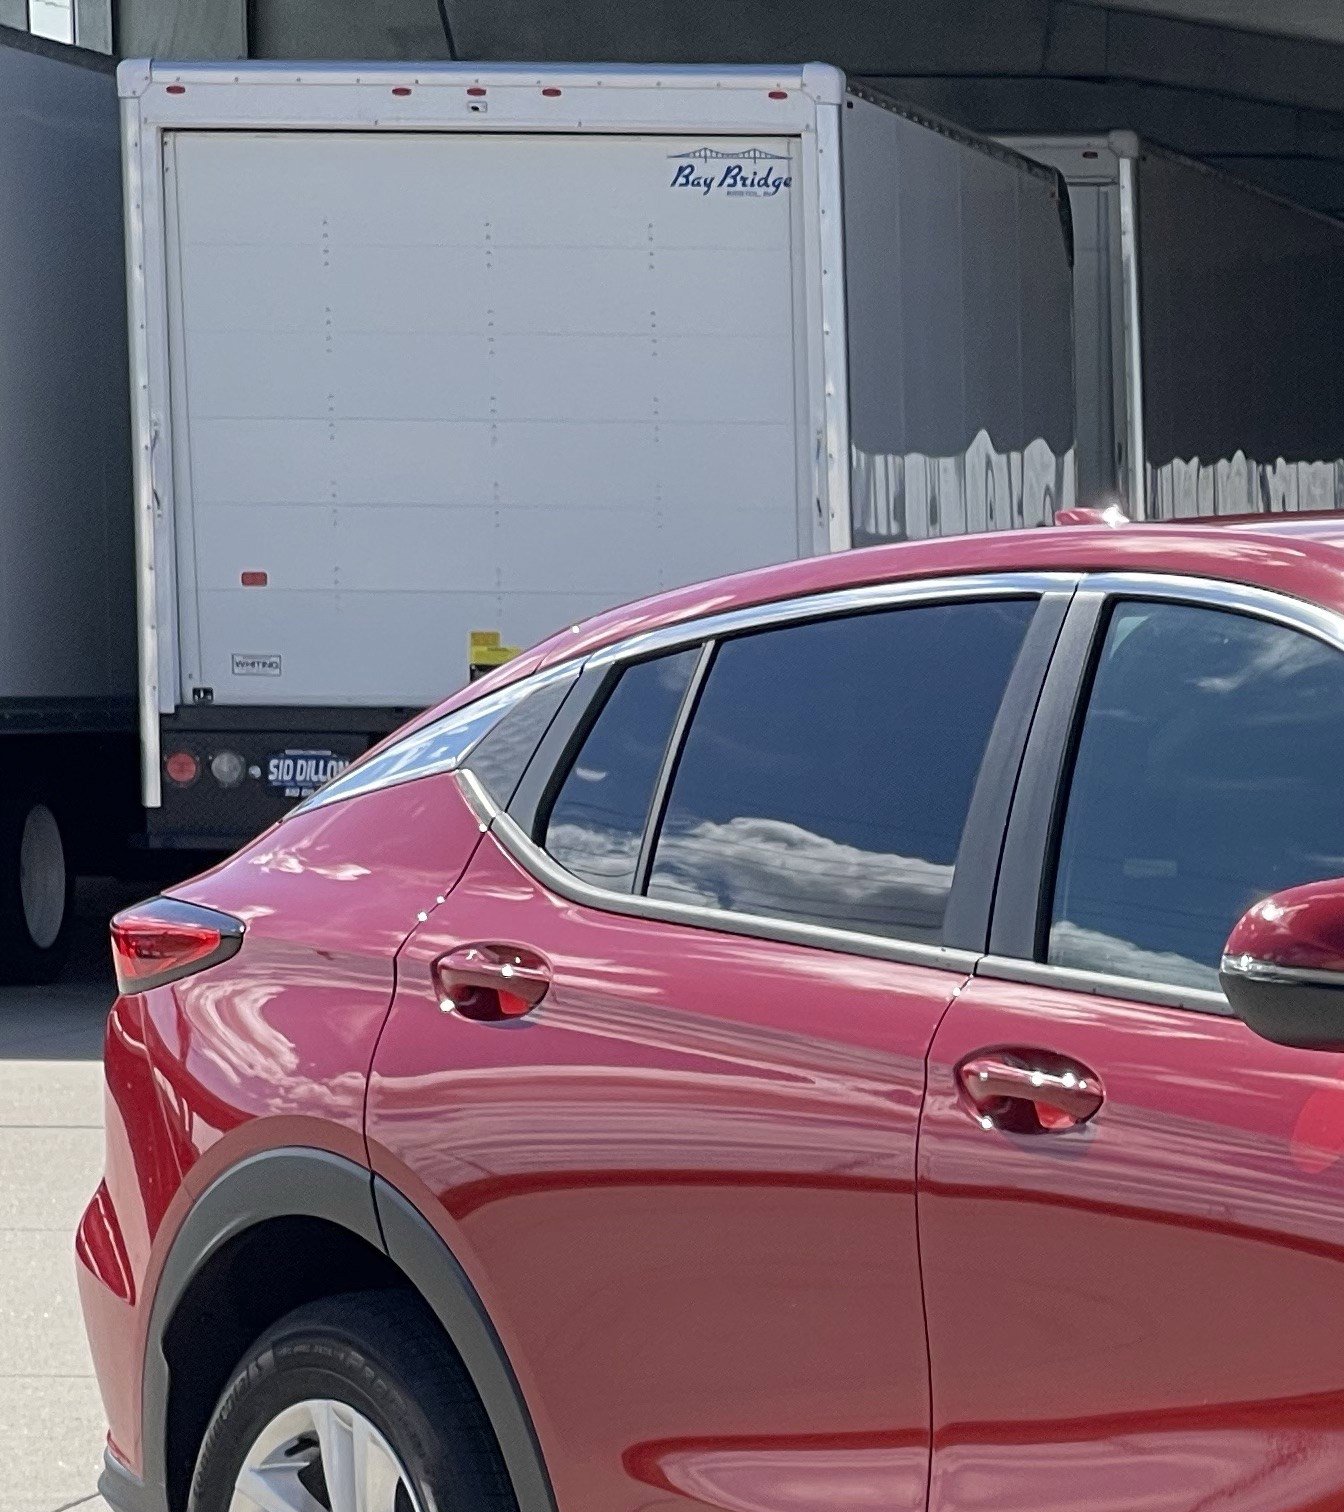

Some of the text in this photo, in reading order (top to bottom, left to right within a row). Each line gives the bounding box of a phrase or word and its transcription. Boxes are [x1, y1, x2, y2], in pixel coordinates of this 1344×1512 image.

[670, 164, 793, 196] Bay Bridge
[268, 759, 294, 781] SID
